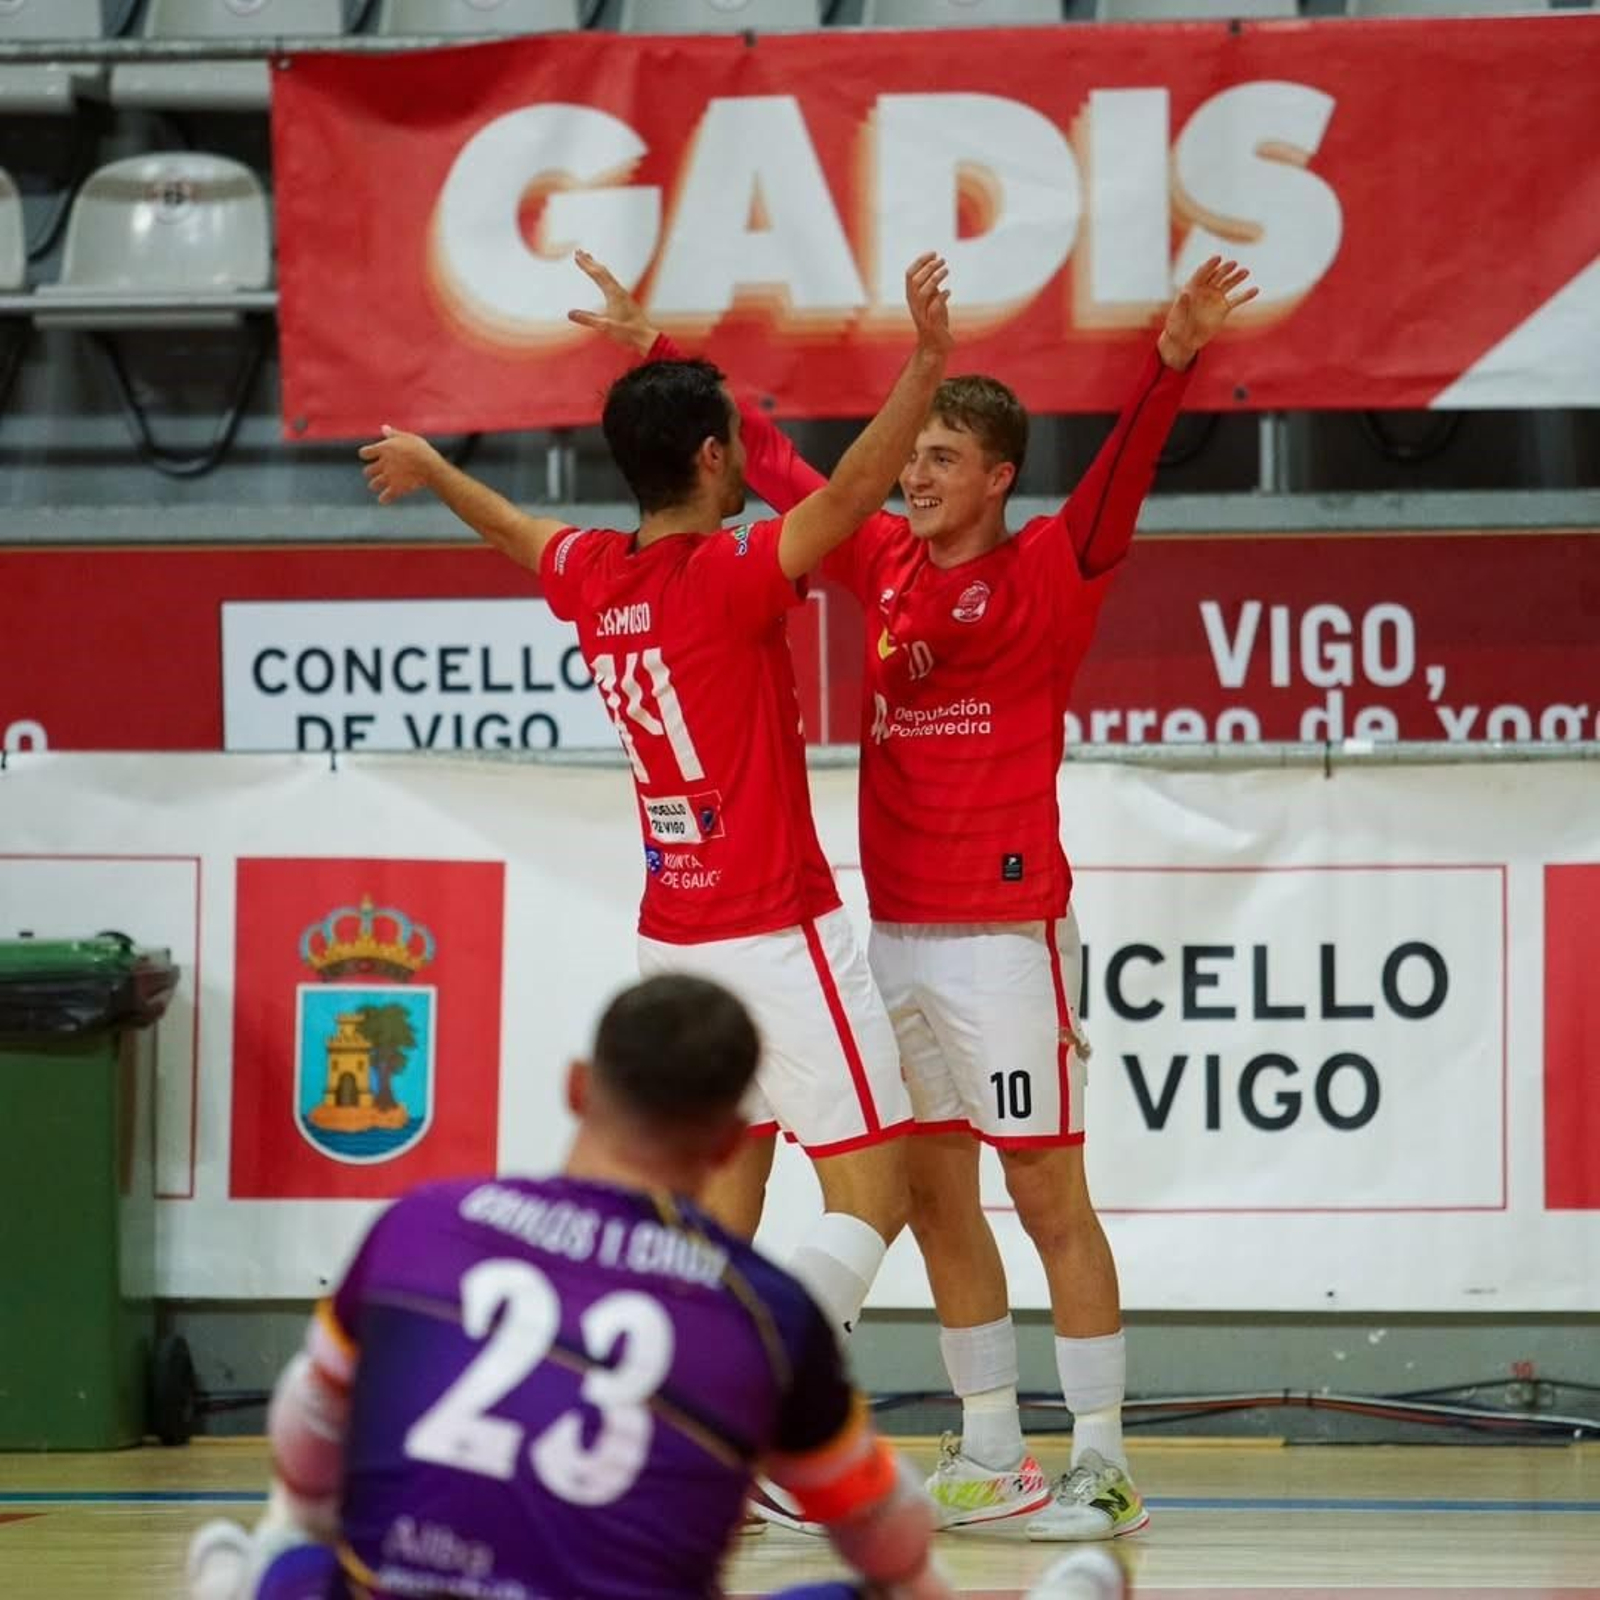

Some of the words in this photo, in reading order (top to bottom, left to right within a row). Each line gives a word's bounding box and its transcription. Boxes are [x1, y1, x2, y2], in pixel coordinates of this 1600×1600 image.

[433, 80, 1342, 338] GADIS
[252, 645, 597, 695] CONCELLO
[1200, 600, 1446, 700] VIGO,
[590, 647, 706, 784] 14
[890, 719, 991, 737] Pontevedra
[895, 699, 991, 725] Deputación
[990, 1070, 1032, 1119] 10
[1123, 1052, 1381, 1131] VIGO
[404, 1258, 675, 1506] 23
